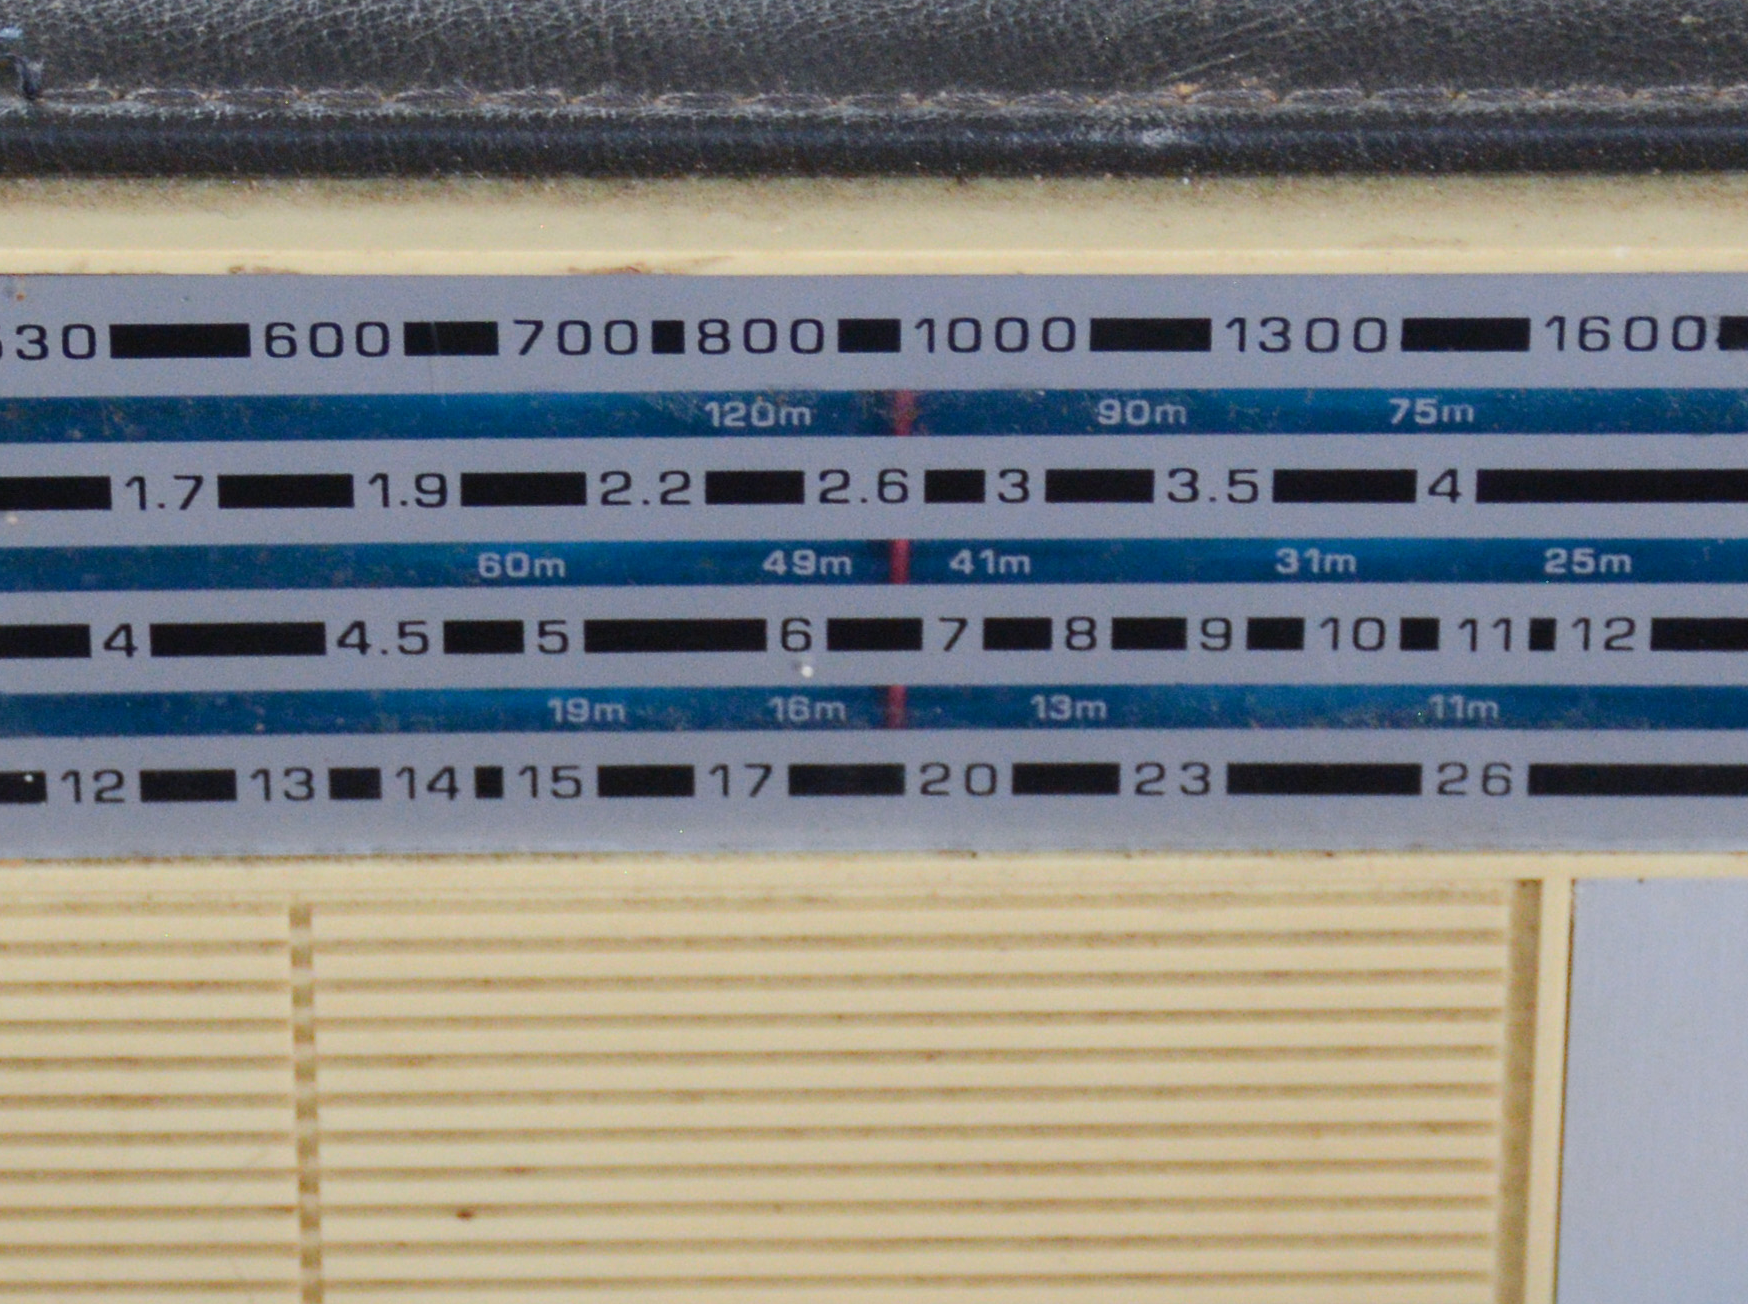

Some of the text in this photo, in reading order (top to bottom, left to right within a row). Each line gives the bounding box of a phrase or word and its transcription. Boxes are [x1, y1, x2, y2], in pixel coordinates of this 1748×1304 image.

[264, 321, 391, 359] 600
[513, 319, 639, 357] 700
[697, 317, 825, 356] 800
[915, 316, 1076, 354] 1000
[1225, 316, 1388, 354] 1300
[1545, 314, 1708, 353] 1600
[704, 397, 1475, 428] 120m 90m 75m
[125, 474, 204, 511] 1.7
[368, 472, 449, 509] 1.9
[599, 469, 692, 507] 2.2
[818, 467, 909, 505] 2.6
[997, 468, 1030, 504] 3
[1167, 467, 1260, 505] 3.5
[1427, 468, 1461, 504] 4
[477, 546, 1632, 578] 60m 49m 41m 31m 25m
[103, 622, 138, 658] 4
[336, 620, 430, 656] 4.5
[537, 619, 570, 655] 5
[780, 617, 813, 653] 6
[939, 616, 969, 652] 7
[1064, 616, 1097, 652] 8
[1200, 617, 1233, 652] 9
[1320, 616, 1387, 652] 10
[1458, 617, 1513, 653] 11
[1572, 616, 1636, 652] 12
[547, 693, 1499, 723] 19m 16m 13m 11m
[61, 768, 125, 804] 12
[250, 766, 316, 802] 13
[396, 765, 460, 801] 14
[518, 764, 583, 800] 15
[709, 762, 773, 798] 17
[919, 762, 998, 797] 20
[1134, 761, 1211, 797] 23
[1436, 761, 1512, 797] 26
